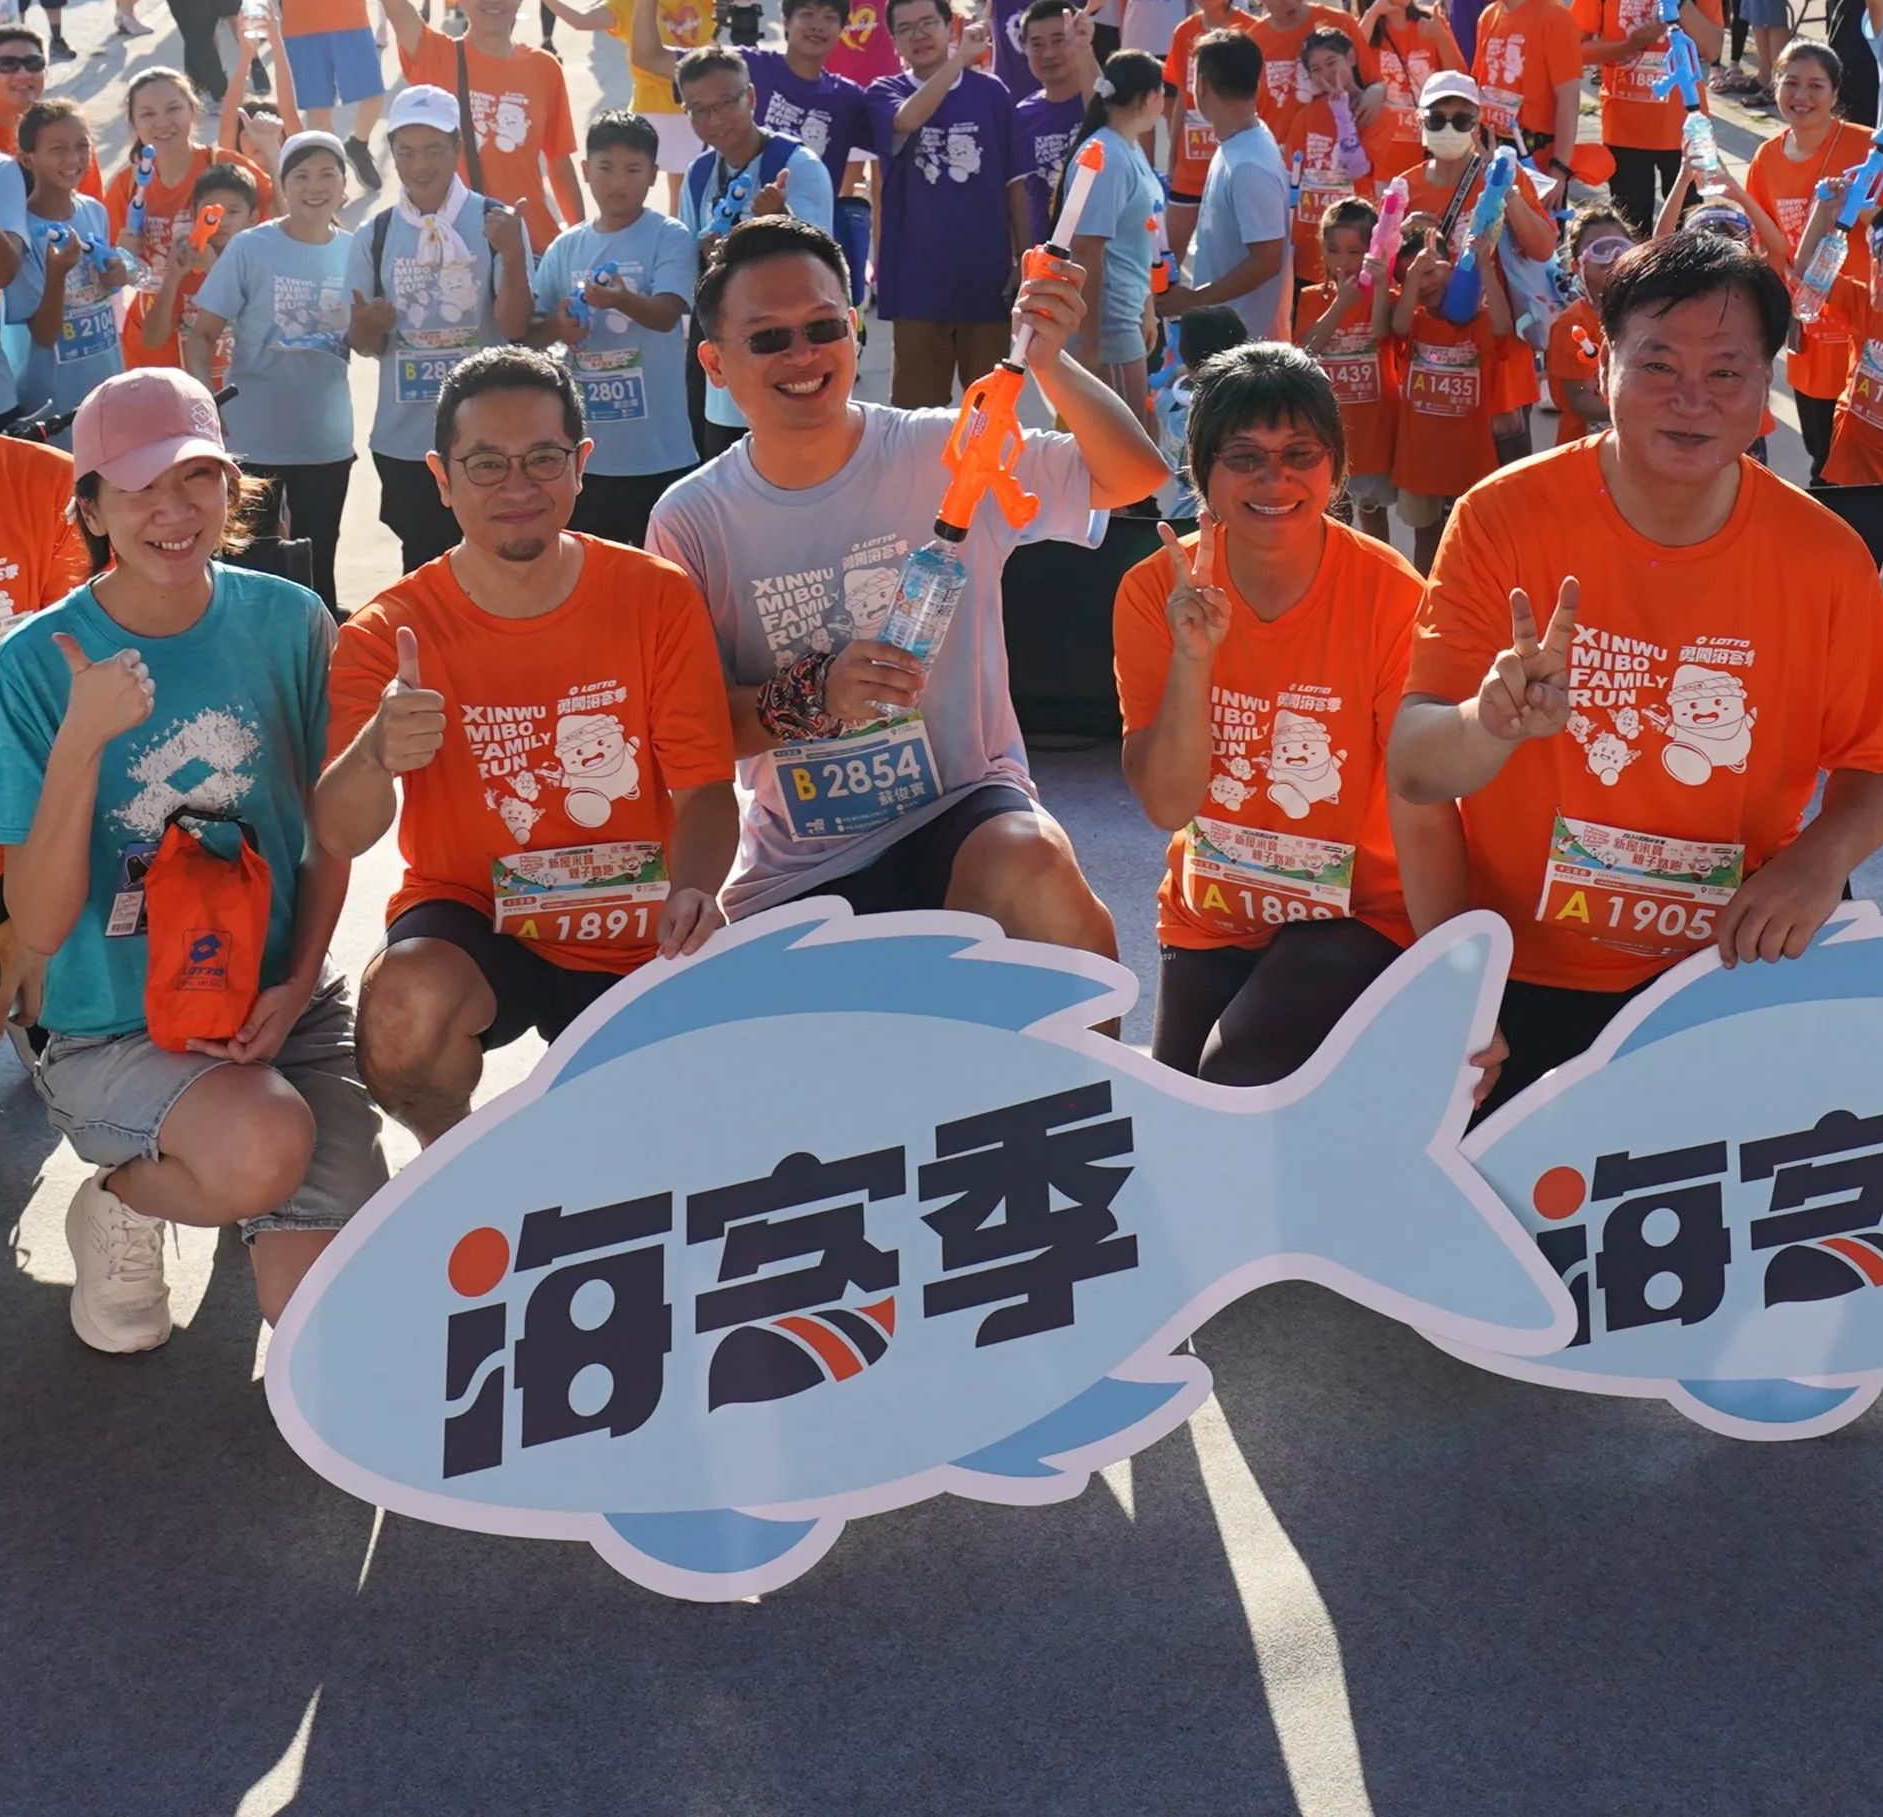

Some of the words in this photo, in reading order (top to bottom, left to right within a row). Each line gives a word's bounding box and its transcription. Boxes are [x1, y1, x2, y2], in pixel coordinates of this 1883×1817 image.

[63, 322, 76, 341] B
[405, 364, 417, 380] B
[588, 378, 637, 402] 2801
[1413, 374, 1426, 391] A
[1431, 376, 1473, 396] 1435
[1857, 378, 1871, 397] A
[861, 533, 897, 550] LOTTO
[750, 565, 835, 597] XINWU
[754, 584, 825, 615] MIBO
[761, 588, 839, 632] FAMILY
[767, 614, 823, 651] RUN
[1572, 623, 1668, 663] XINWU
[1709, 637, 1751, 648] LOTTO
[1571, 646, 1650, 672] MIBO
[581, 679, 617, 693] LOTTO
[1570, 667, 1669, 690] FAMILY
[1211, 686, 1271, 712] INWU
[1569, 689, 1637, 708] RUN
[462, 704, 547, 725] XINWU
[1213, 705, 1256, 724] IBO
[466, 720, 534, 742] MIBO
[473, 731, 552, 761] FAMILY
[1211, 740, 1246, 755] UN
[480, 753, 529, 781] RUN
[790, 768, 818, 801] B
[821, 745, 922, 799] 2854
[1202, 883, 1232, 915] A
[517, 918, 541, 940] A
[555, 907, 650, 942] 1891
[1555, 889, 1590, 924] A
[1607, 895, 1717, 940] 1905
[441, 1078, 1140, 1480] 海客季
